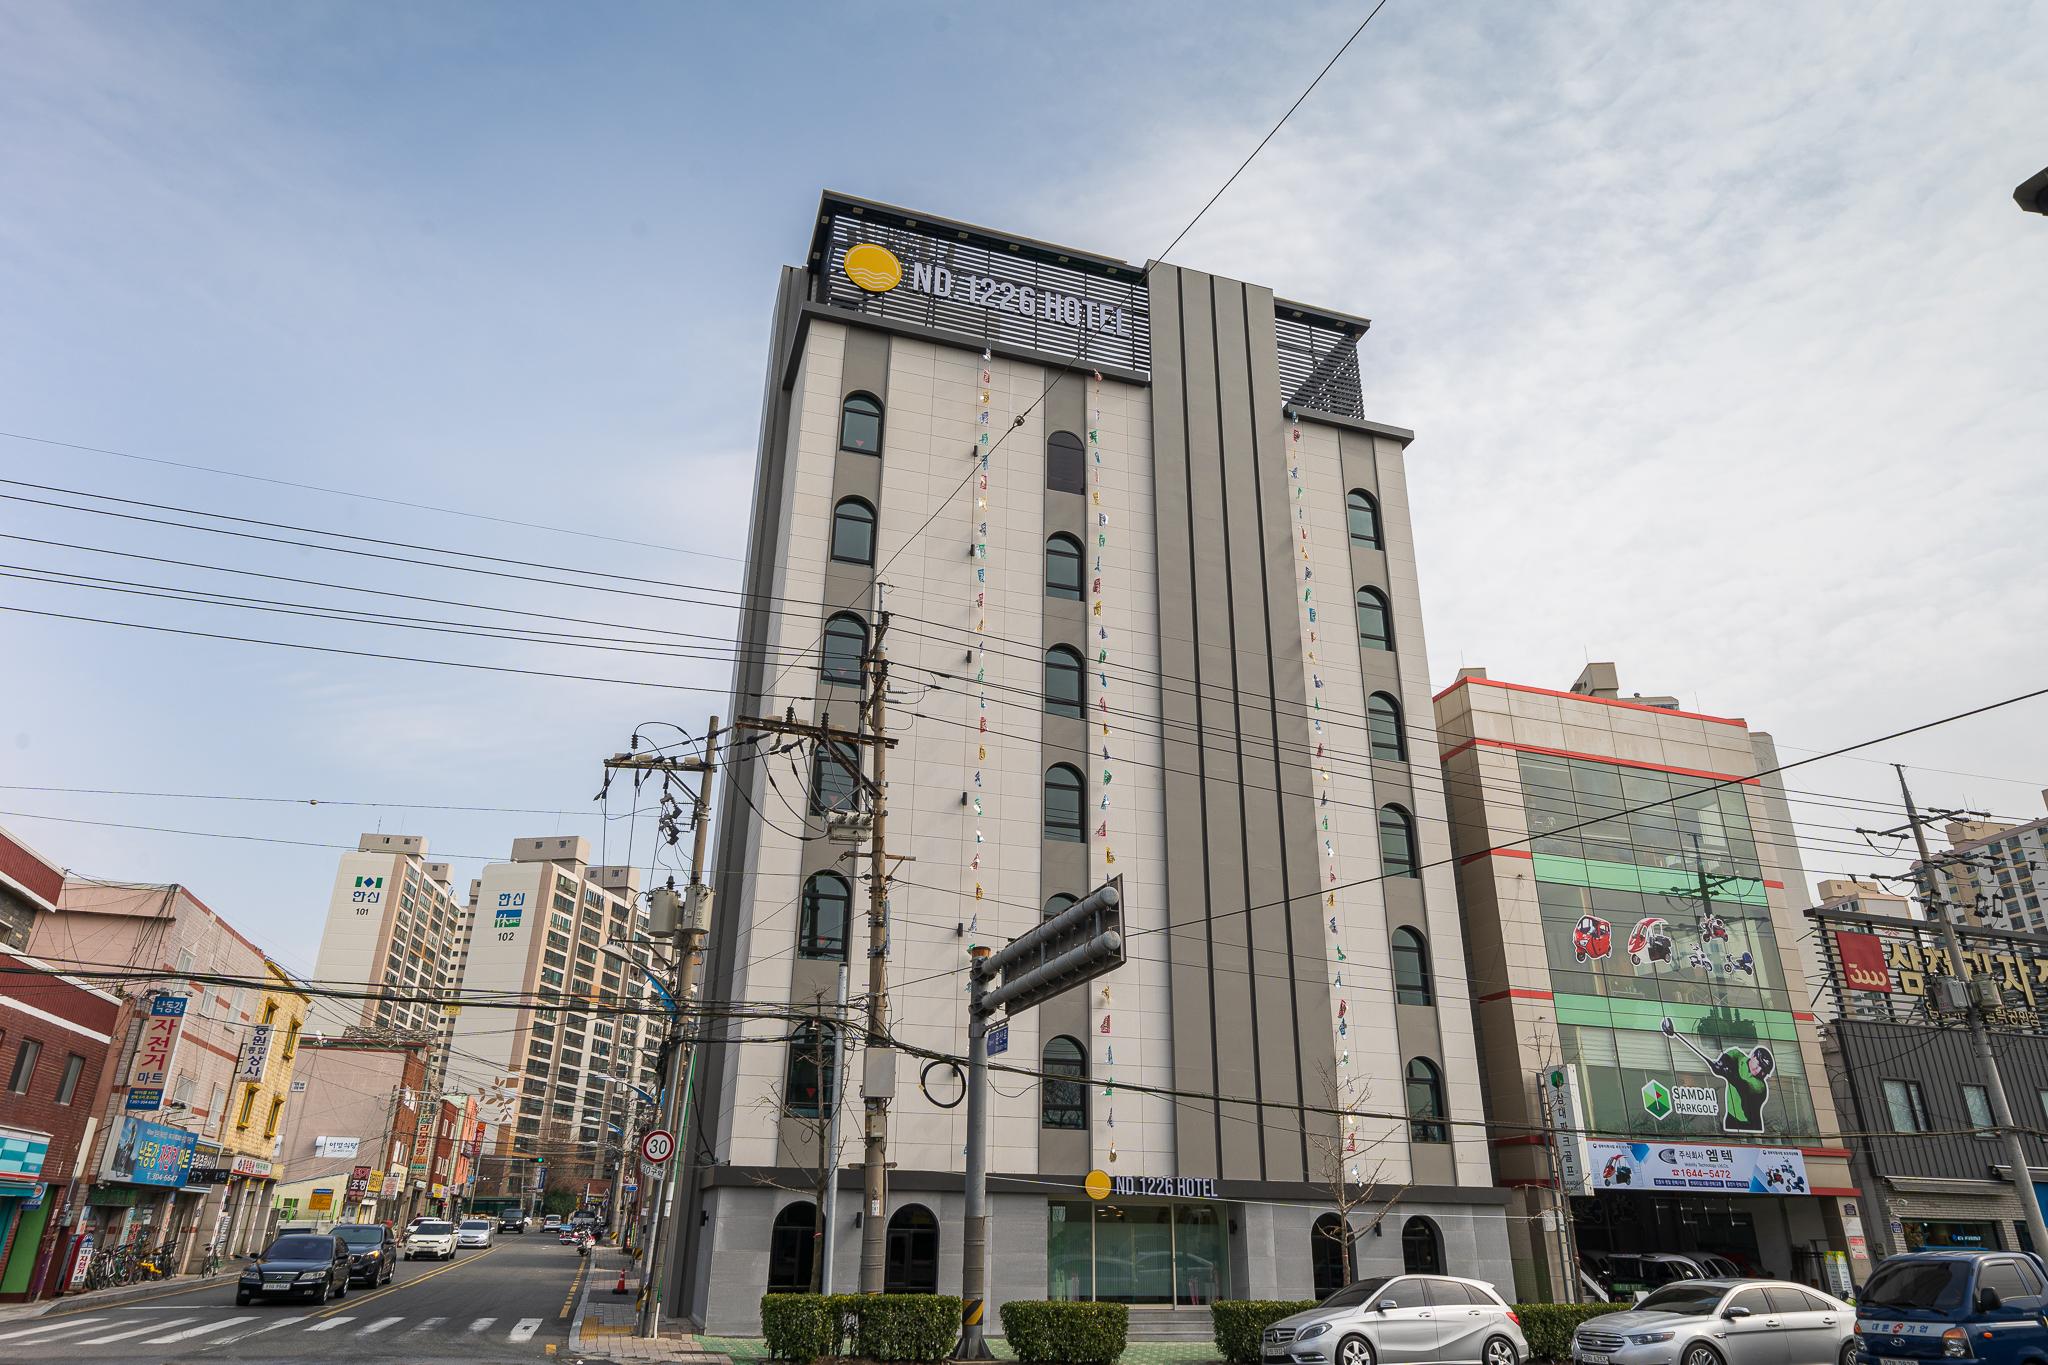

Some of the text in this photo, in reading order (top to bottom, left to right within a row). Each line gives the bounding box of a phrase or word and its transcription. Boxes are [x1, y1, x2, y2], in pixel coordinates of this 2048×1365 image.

[913, 262, 1131, 338] ND. 1226 HOTEL
[352, 890, 380, 904] 한신
[498, 892, 526, 907] 한신
[355, 907, 369, 916] 101
[497, 932, 514, 942] 102
[156, 1000, 184, 1014] 낙동강
[141, 1018, 177, 1071] 자전거
[137, 1072, 164, 1085] 마트
[1673, 1088, 1715, 1102] SAMDAI
[1676, 1103, 1717, 1114] PARKGOLF
[649, 1138, 668, 1155] 30
[138, 1140, 159, 1169] 낙동강
[158, 1144, 178, 1174] 자전거
[177, 1148, 191, 1172] 마트
[1679, 1151, 1704, 1160] 주식회사
[1681, 1169, 1732, 1179] 1644-5472
[350, 1179, 367, 1191] 조명
[1116, 1176, 1219, 1198] ND. 1226 HOTEL
